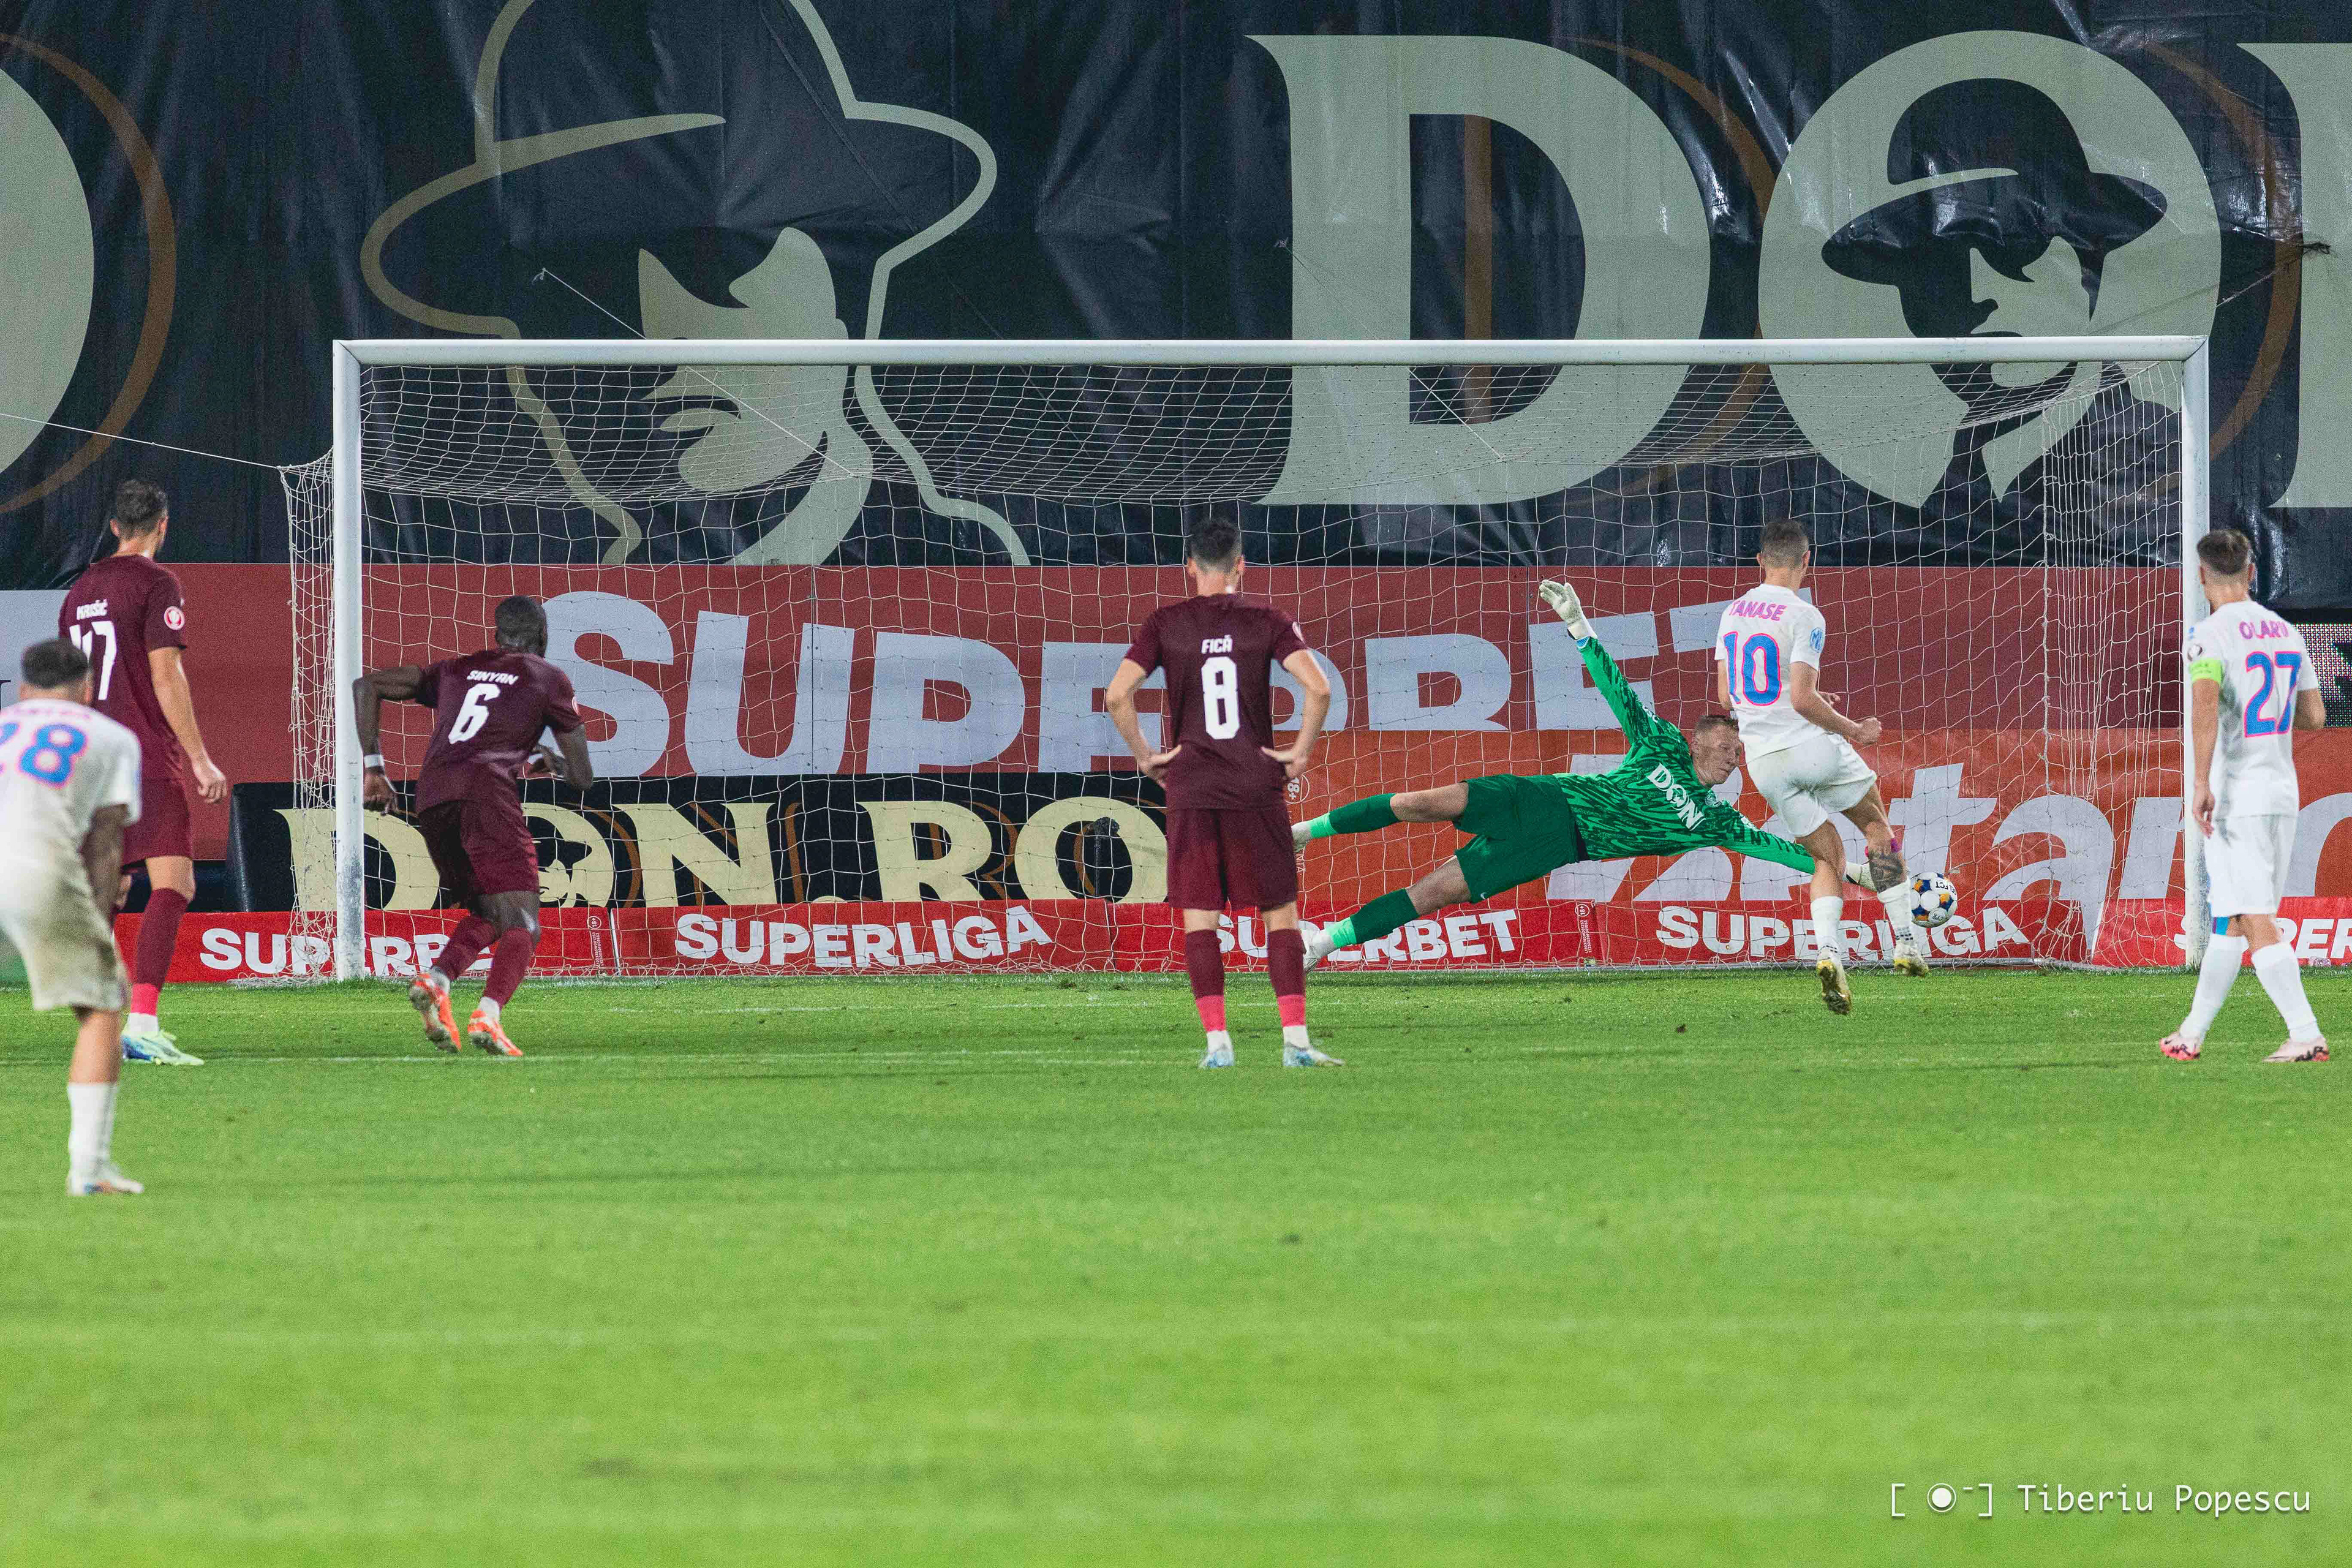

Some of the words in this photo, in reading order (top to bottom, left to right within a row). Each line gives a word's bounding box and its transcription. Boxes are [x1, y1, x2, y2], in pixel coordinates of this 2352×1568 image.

[1243, 29, 2352, 508] DO
[537, 586, 1813, 779] SUPEBE
[1201, 656, 1240, 740] 8
[1723, 630, 1782, 706] 10
[2244, 650, 2302, 738] 27
[448, 683, 502, 745] 6
[1646, 763, 1707, 831] DON
[273, 795, 1168, 911] DONRO
[674, 905, 1053, 968] SUPERLIGA
